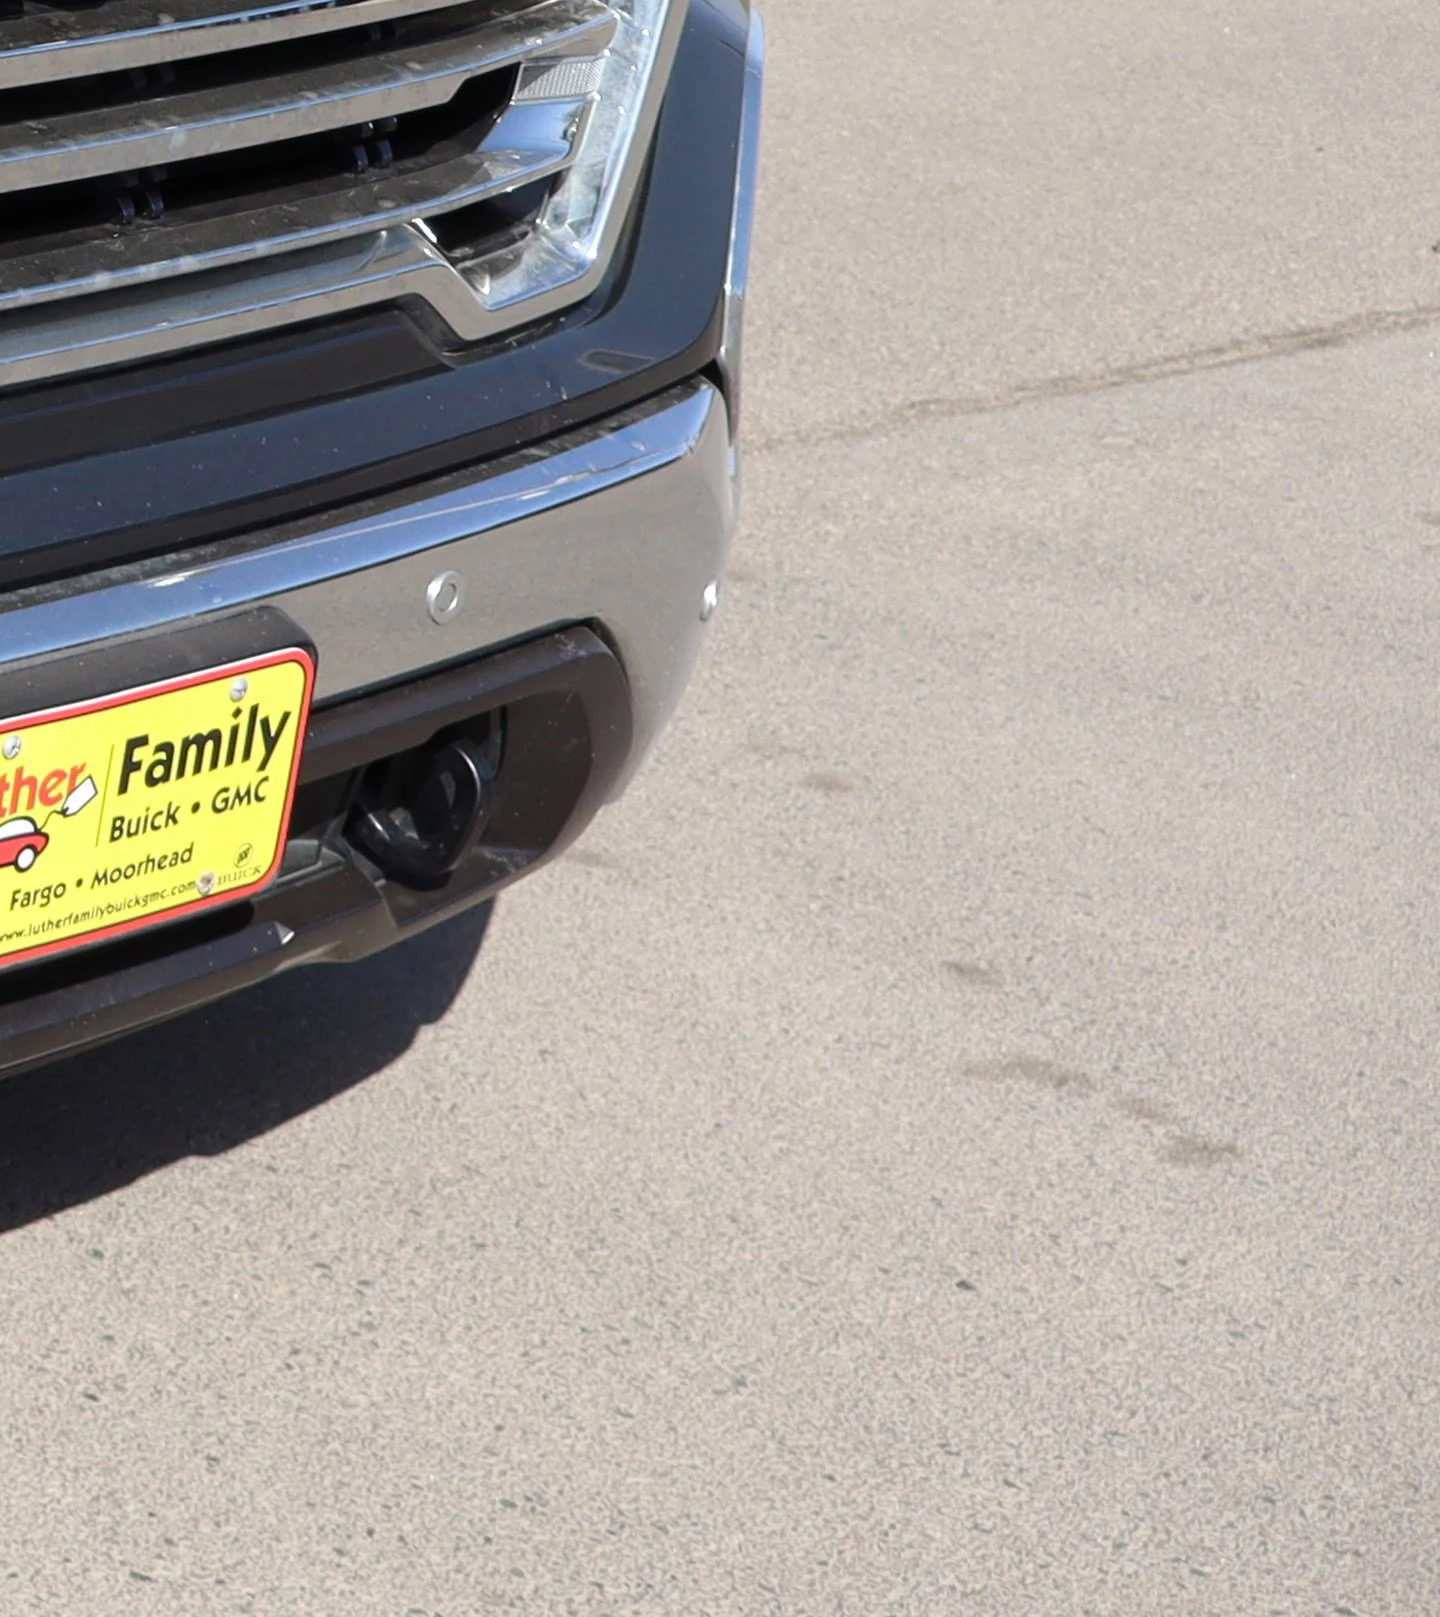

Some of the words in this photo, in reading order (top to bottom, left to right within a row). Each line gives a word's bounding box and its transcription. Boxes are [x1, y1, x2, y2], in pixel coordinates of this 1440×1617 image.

[117, 702, 292, 797] Family
[109, 800, 181, 844] Buick
[211, 775, 270, 813] GMC
[9, 881, 68, 911] Fargo
[90, 841, 195, 891] Moorhead
